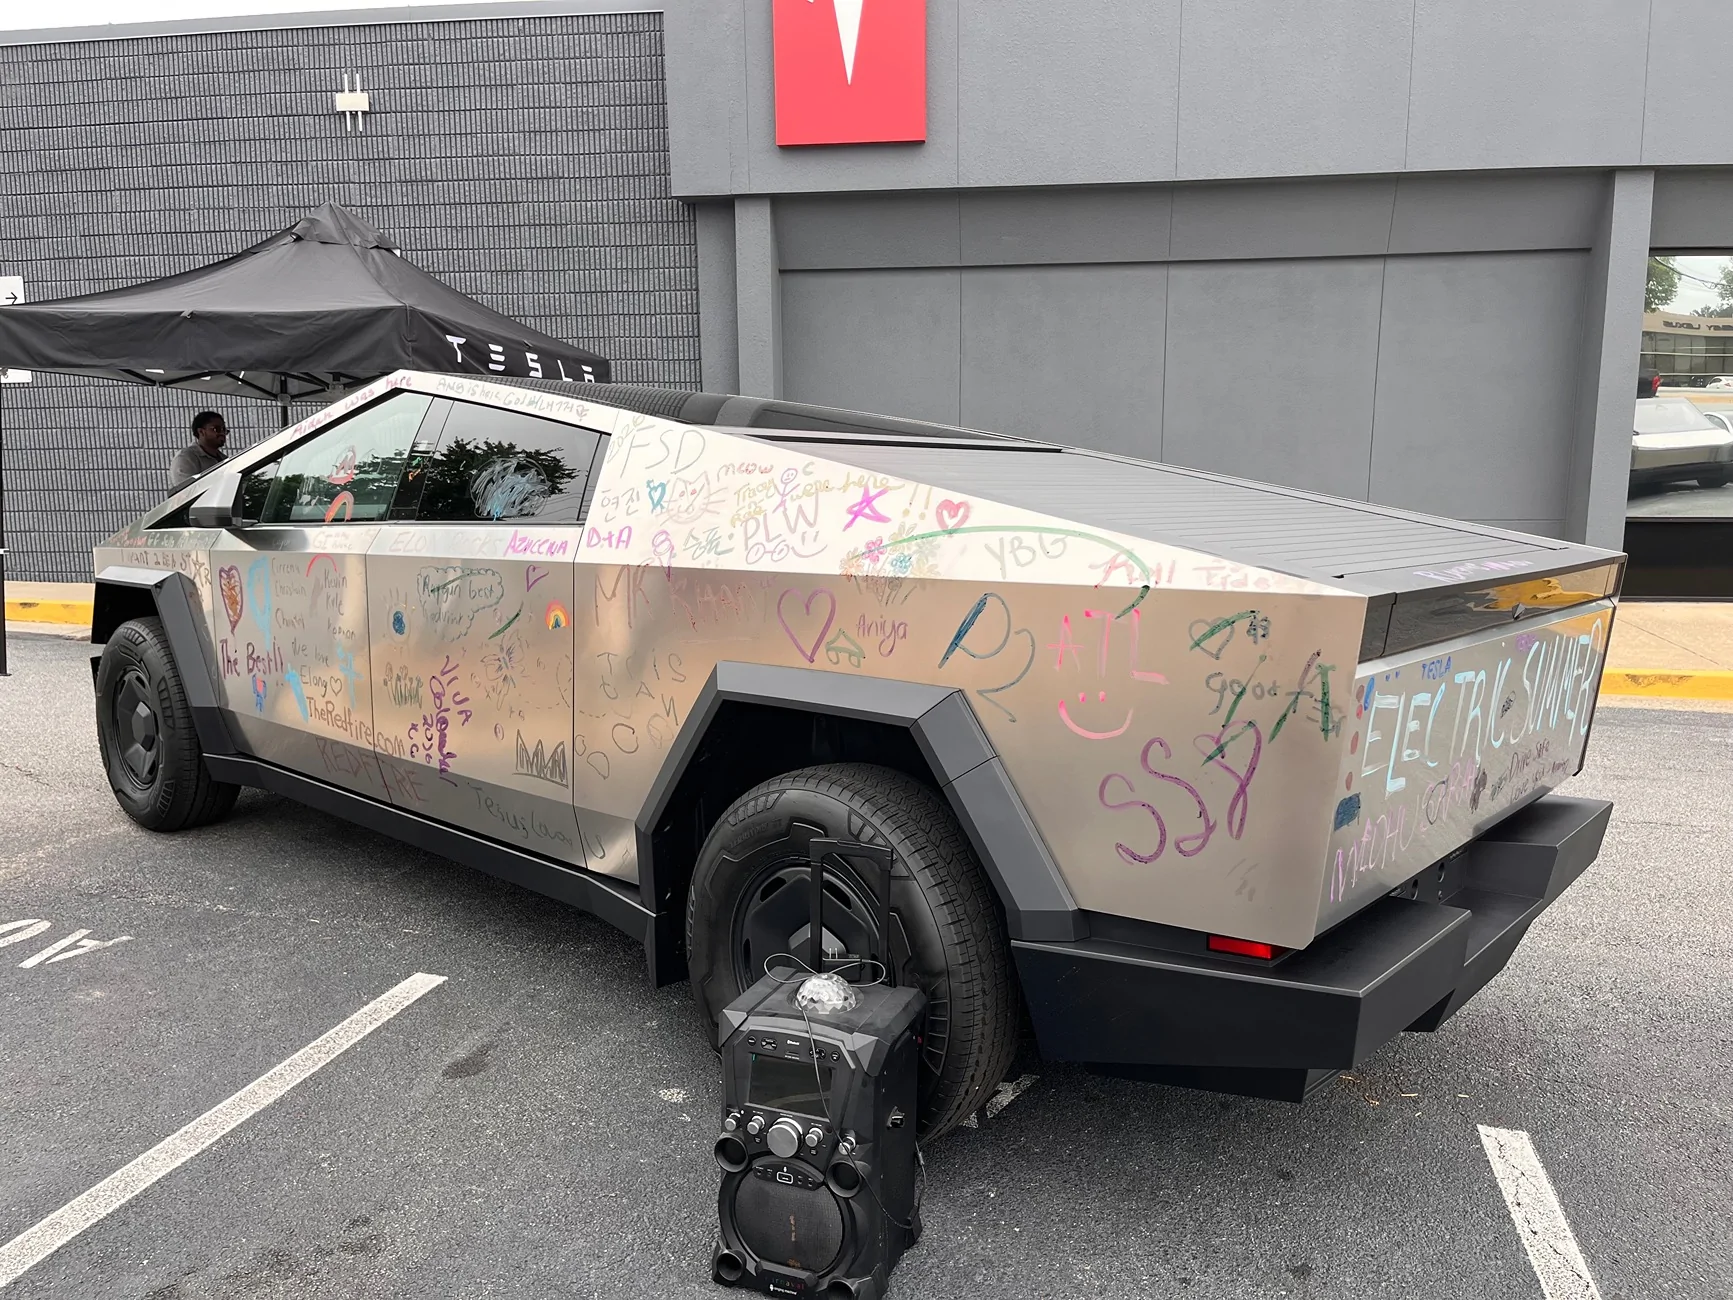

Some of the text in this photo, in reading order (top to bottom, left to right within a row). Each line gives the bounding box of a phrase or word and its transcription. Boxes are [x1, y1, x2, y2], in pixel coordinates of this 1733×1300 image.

[445, 334, 596, 383] TESLA
[344, 388, 375, 410] was
[620, 424, 706, 478] FSD
[1361, 657, 1511, 793] ELECTRIC
